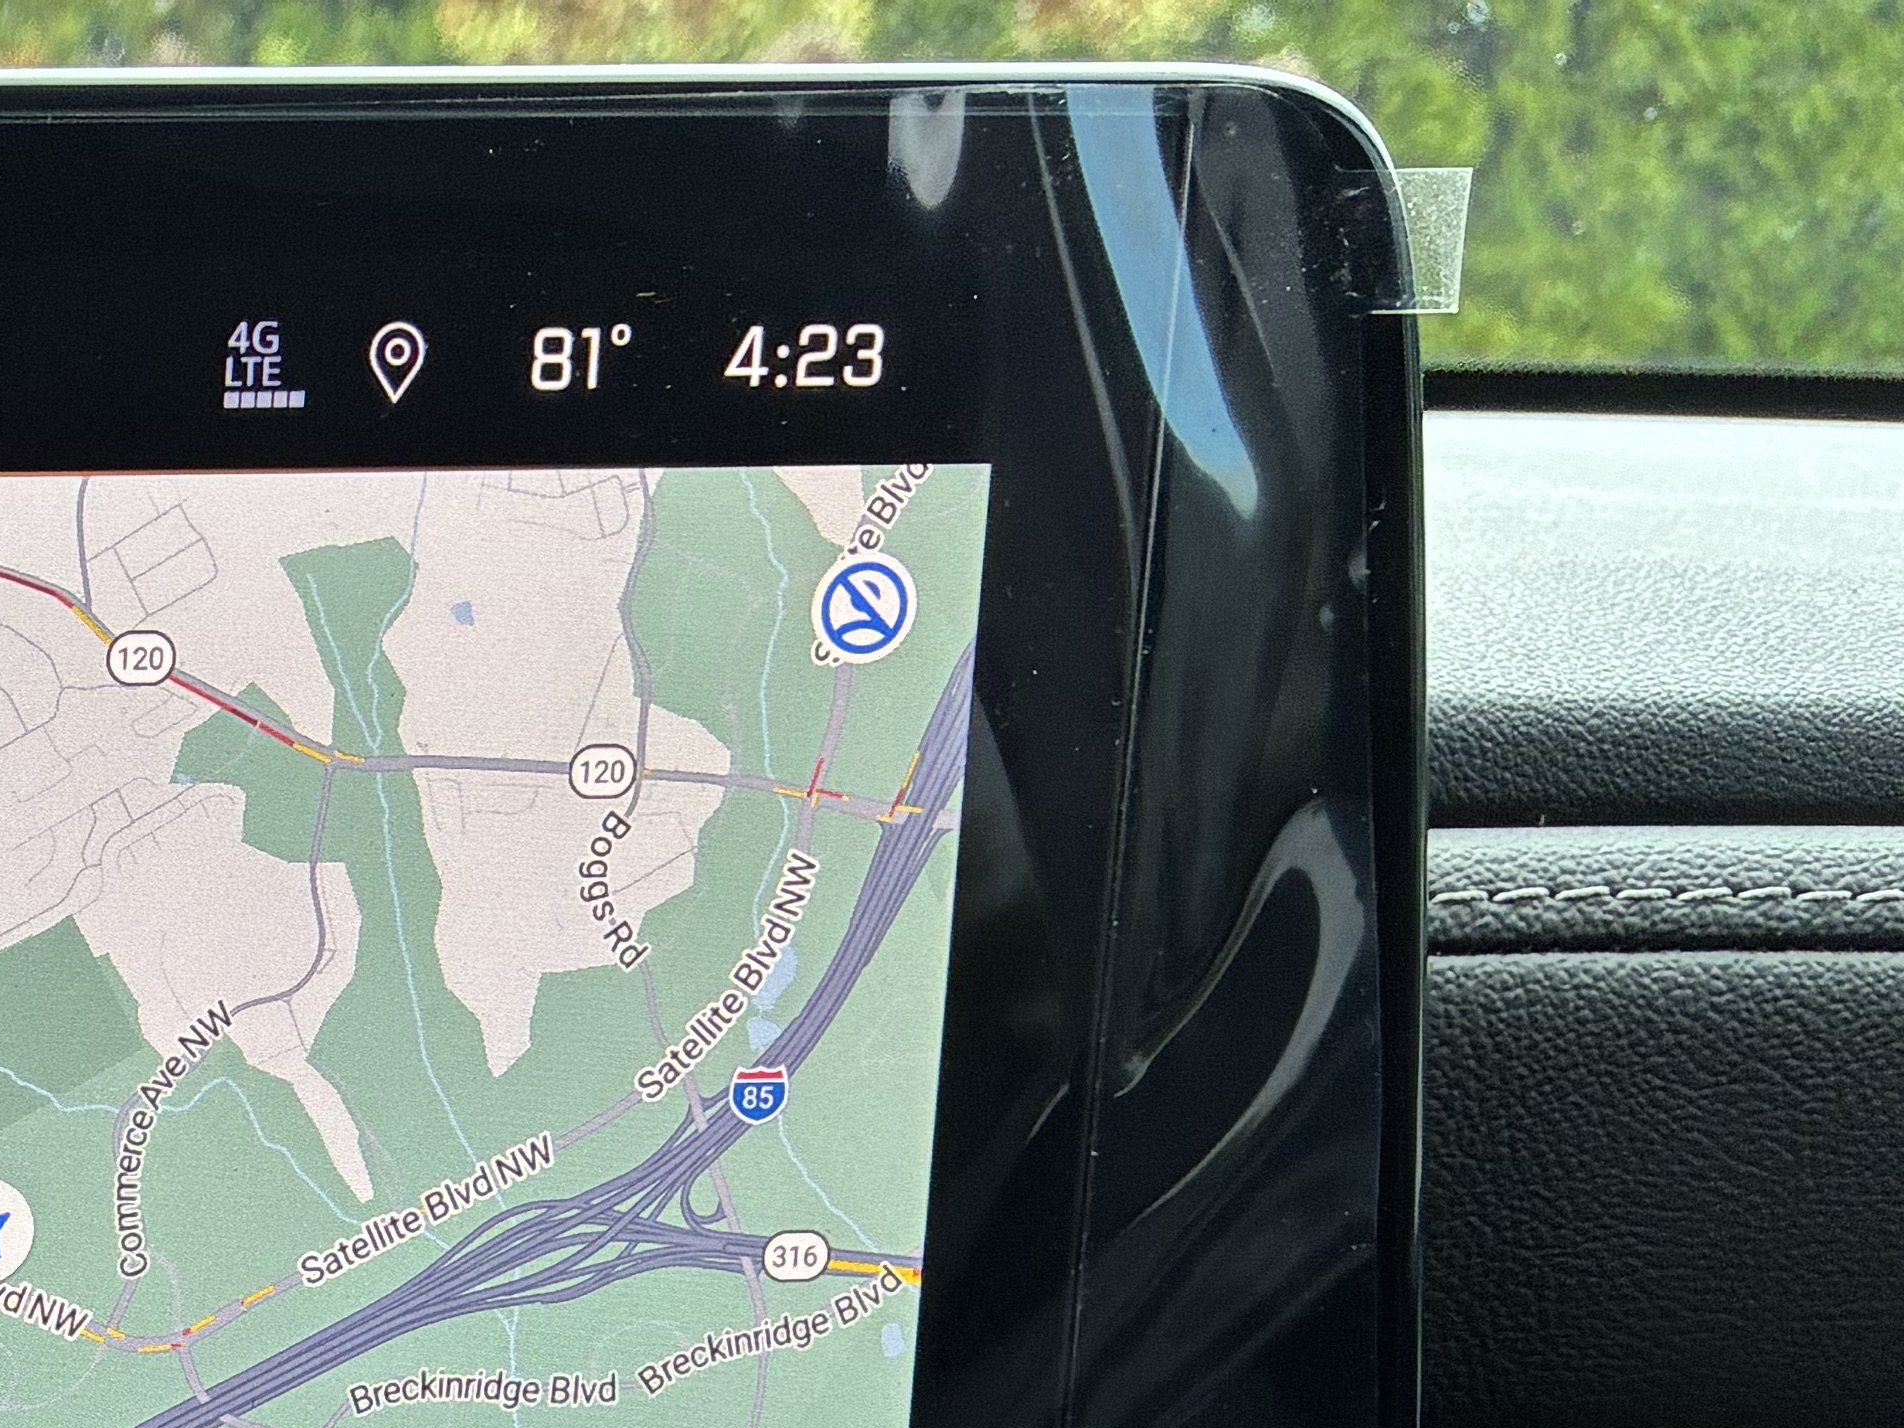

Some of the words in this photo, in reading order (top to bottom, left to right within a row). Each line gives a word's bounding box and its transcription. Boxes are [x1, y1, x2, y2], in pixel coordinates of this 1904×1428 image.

[226, 320, 280, 354] 4G
[725, 322, 886, 388] 4:23
[224, 356, 282, 388] LTE
[117, 646, 165, 671] 120
[580, 759, 625, 783] 120
[579, 811, 632, 922] Boggs
[604, 922, 649, 970] Rd
[637, 992, 744, 1099] Satellite
[735, 919, 791, 991] Blvd
[774, 852, 817, 919] NW
[741, 1086, 774, 1110] 85
[116, 1108, 155, 1278] Commerce
[141, 1056, 186, 1111] Ave
[178, 1000, 232, 1058] NW
[299, 1213, 423, 1286] Satellite
[422, 1167, 495, 1224] Blvd
[495, 1136, 554, 1190] NW
[772, 1246, 818, 1270] 316
[29, 1292, 88, 1337] NW
[638, 1312, 830, 1394] Breckinridge
[835, 1266, 902, 1328] Blvd
[350, 1370, 542, 1414] Breckinridge
[550, 1374, 617, 1404] Blvd
